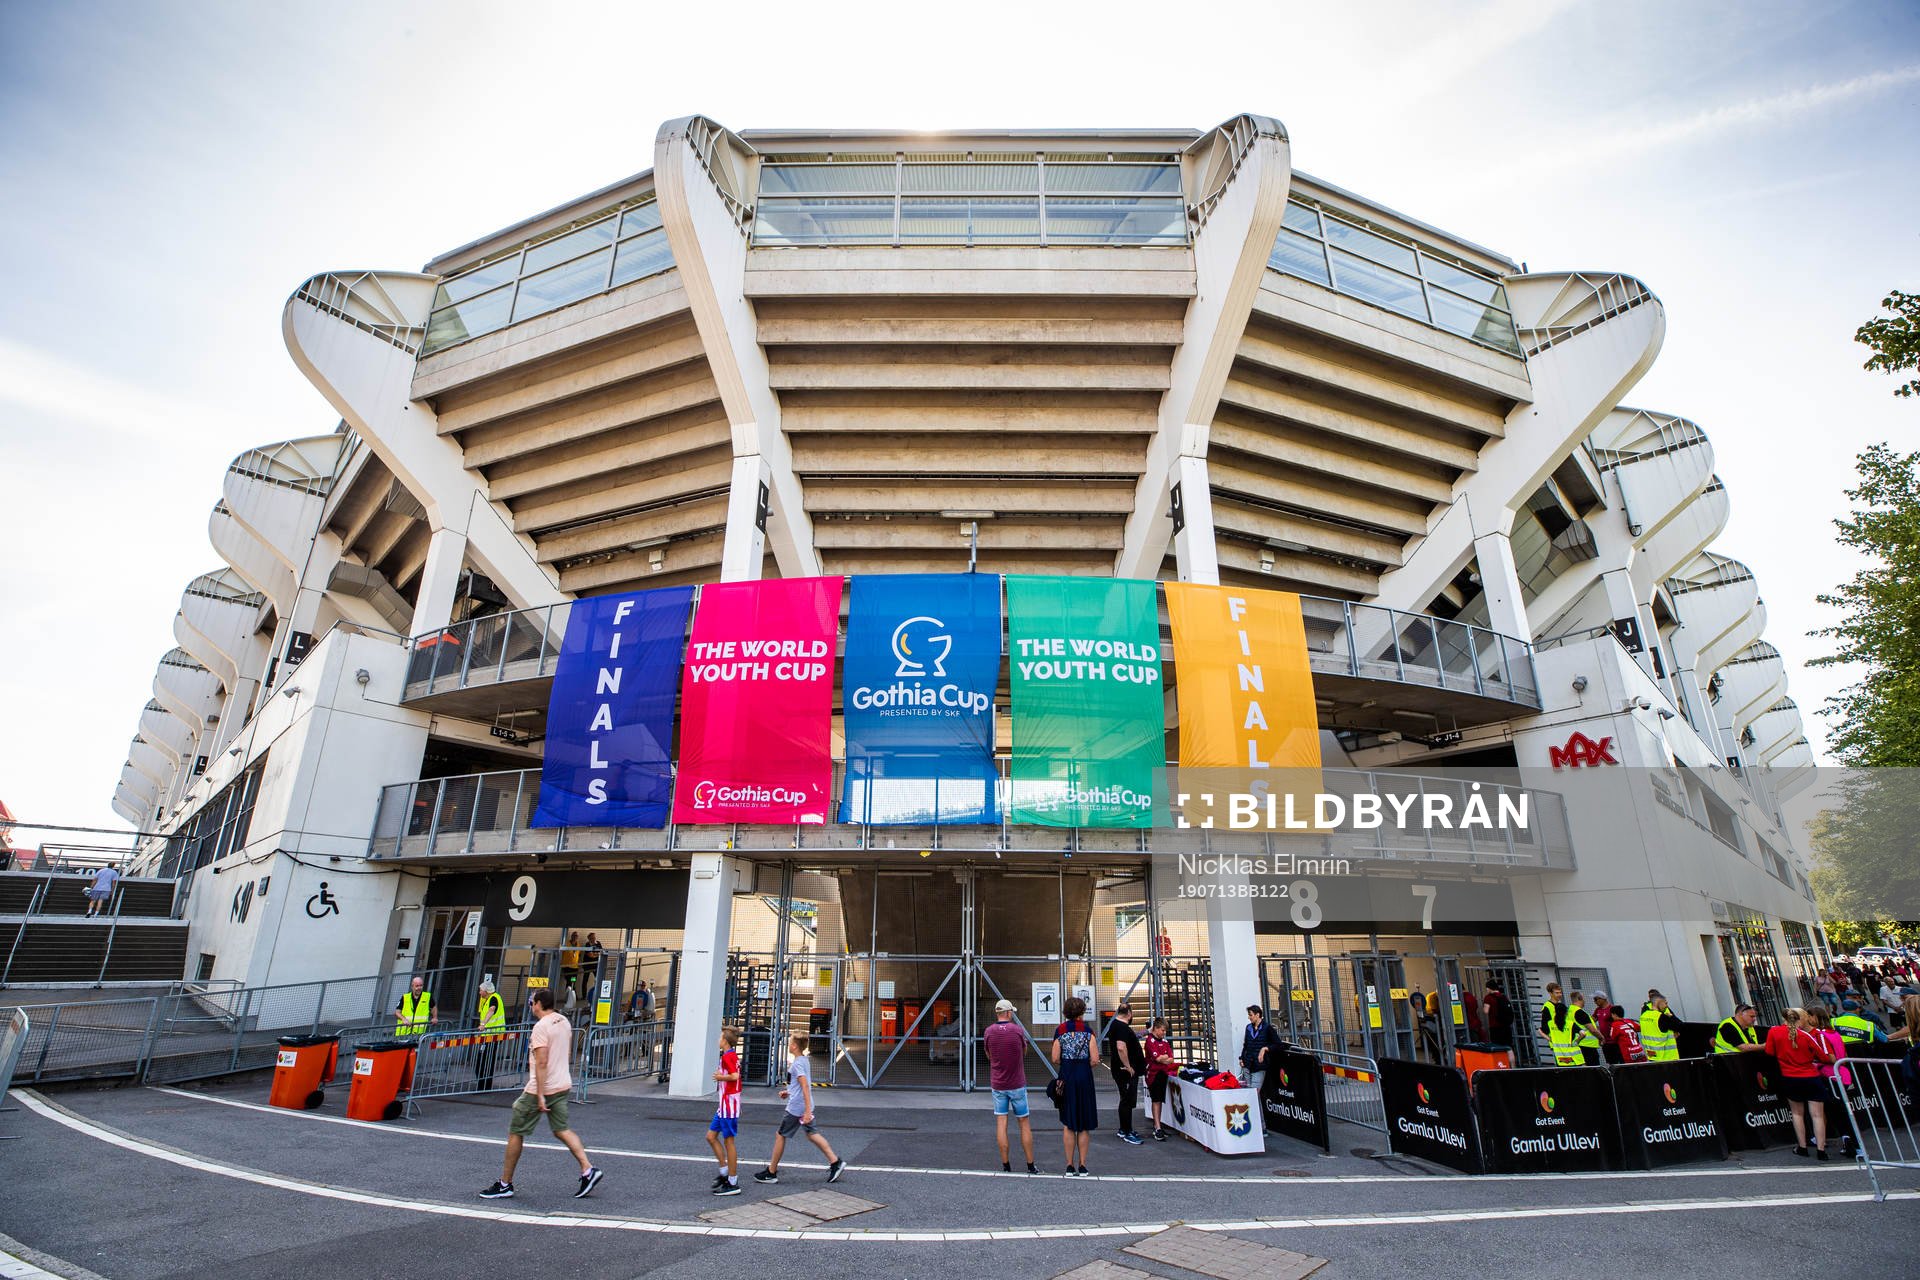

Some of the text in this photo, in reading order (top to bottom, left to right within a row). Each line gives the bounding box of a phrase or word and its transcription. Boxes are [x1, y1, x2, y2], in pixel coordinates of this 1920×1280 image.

[1623, 621, 1633, 637] J
[294, 635, 304, 649] L
[693, 640, 828, 660] THE WORLD
[1016, 638, 1157, 662] THE WORLD
[690, 662, 827, 683] YOUTH CUP
[1018, 660, 1159, 685] YOUTH CUP
[585, 600, 635, 805] FINALS
[852, 681, 989, 715] Gothia Cup
[1227, 596, 1269, 809] FINALS
[879, 708, 929, 717] PRESENTED
[931, 708, 943, 717] BY
[1548, 731, 1619, 770] MAX
[717, 785, 807, 806] Gothia Cup
[1065, 786, 1152, 810] Gothia Cup
[508, 876, 537, 921] 9
[1290, 879, 1323, 929] 8
[1411, 884, 1438, 930] 7
[1266, 1098, 1315, 1125] Gamla Ullevi
[1416, 1105, 1440, 1118] Got Event
[1535, 1117, 1566, 1127] Got Event
[1663, 1106, 1686, 1116] Got Event
[1745, 1107, 1793, 1128] Gamla Ulle
[1398, 1117, 1467, 1150] Gamla Ullevi
[1510, 1132, 1600, 1155] Gamla Ullevi
[1643, 1120, 1717, 1144] Gamla Ullevi
